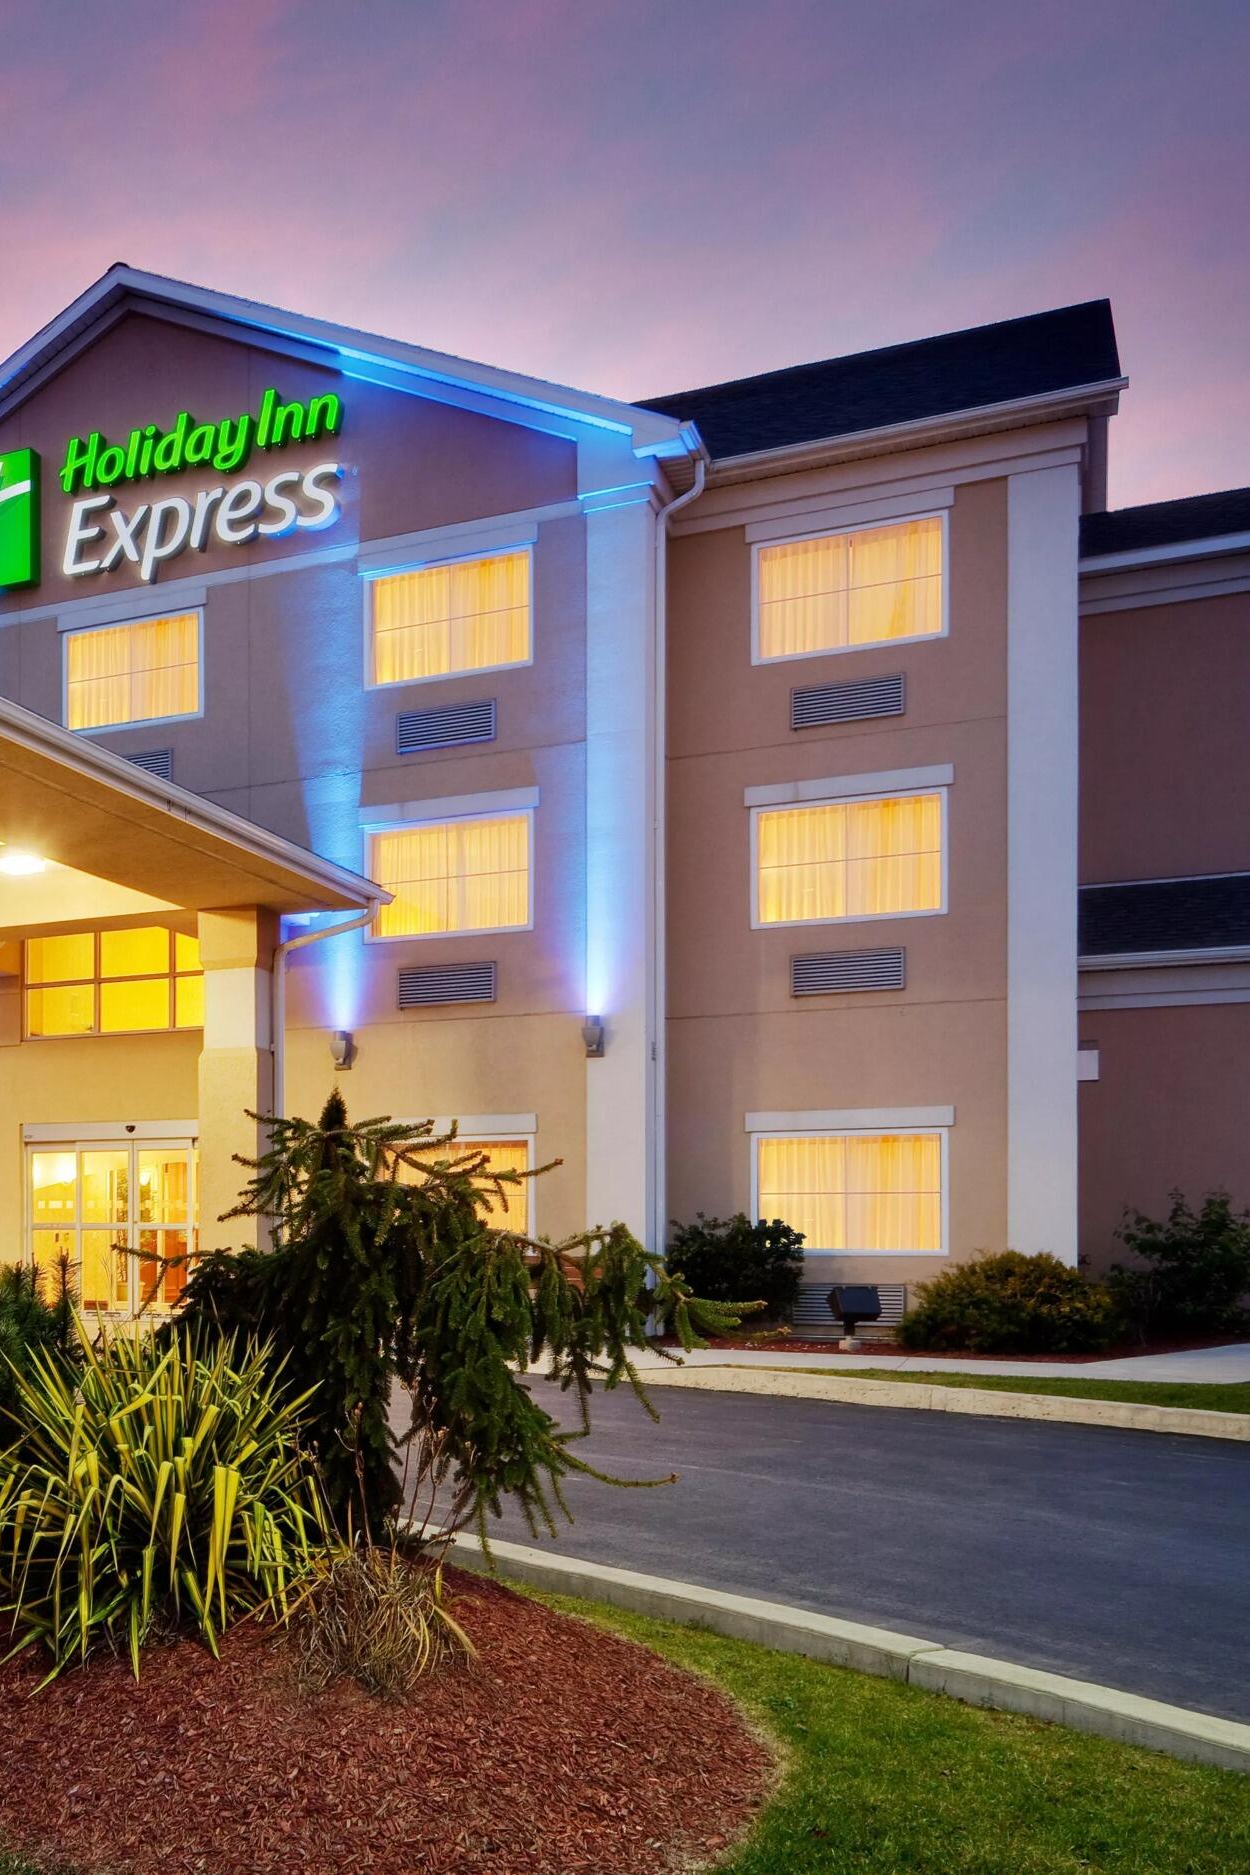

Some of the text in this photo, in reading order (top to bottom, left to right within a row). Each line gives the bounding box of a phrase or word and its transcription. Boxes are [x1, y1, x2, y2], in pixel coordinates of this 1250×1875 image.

[60, 388, 343, 494] Holiday Inn
[63, 463, 342, 582] Express
